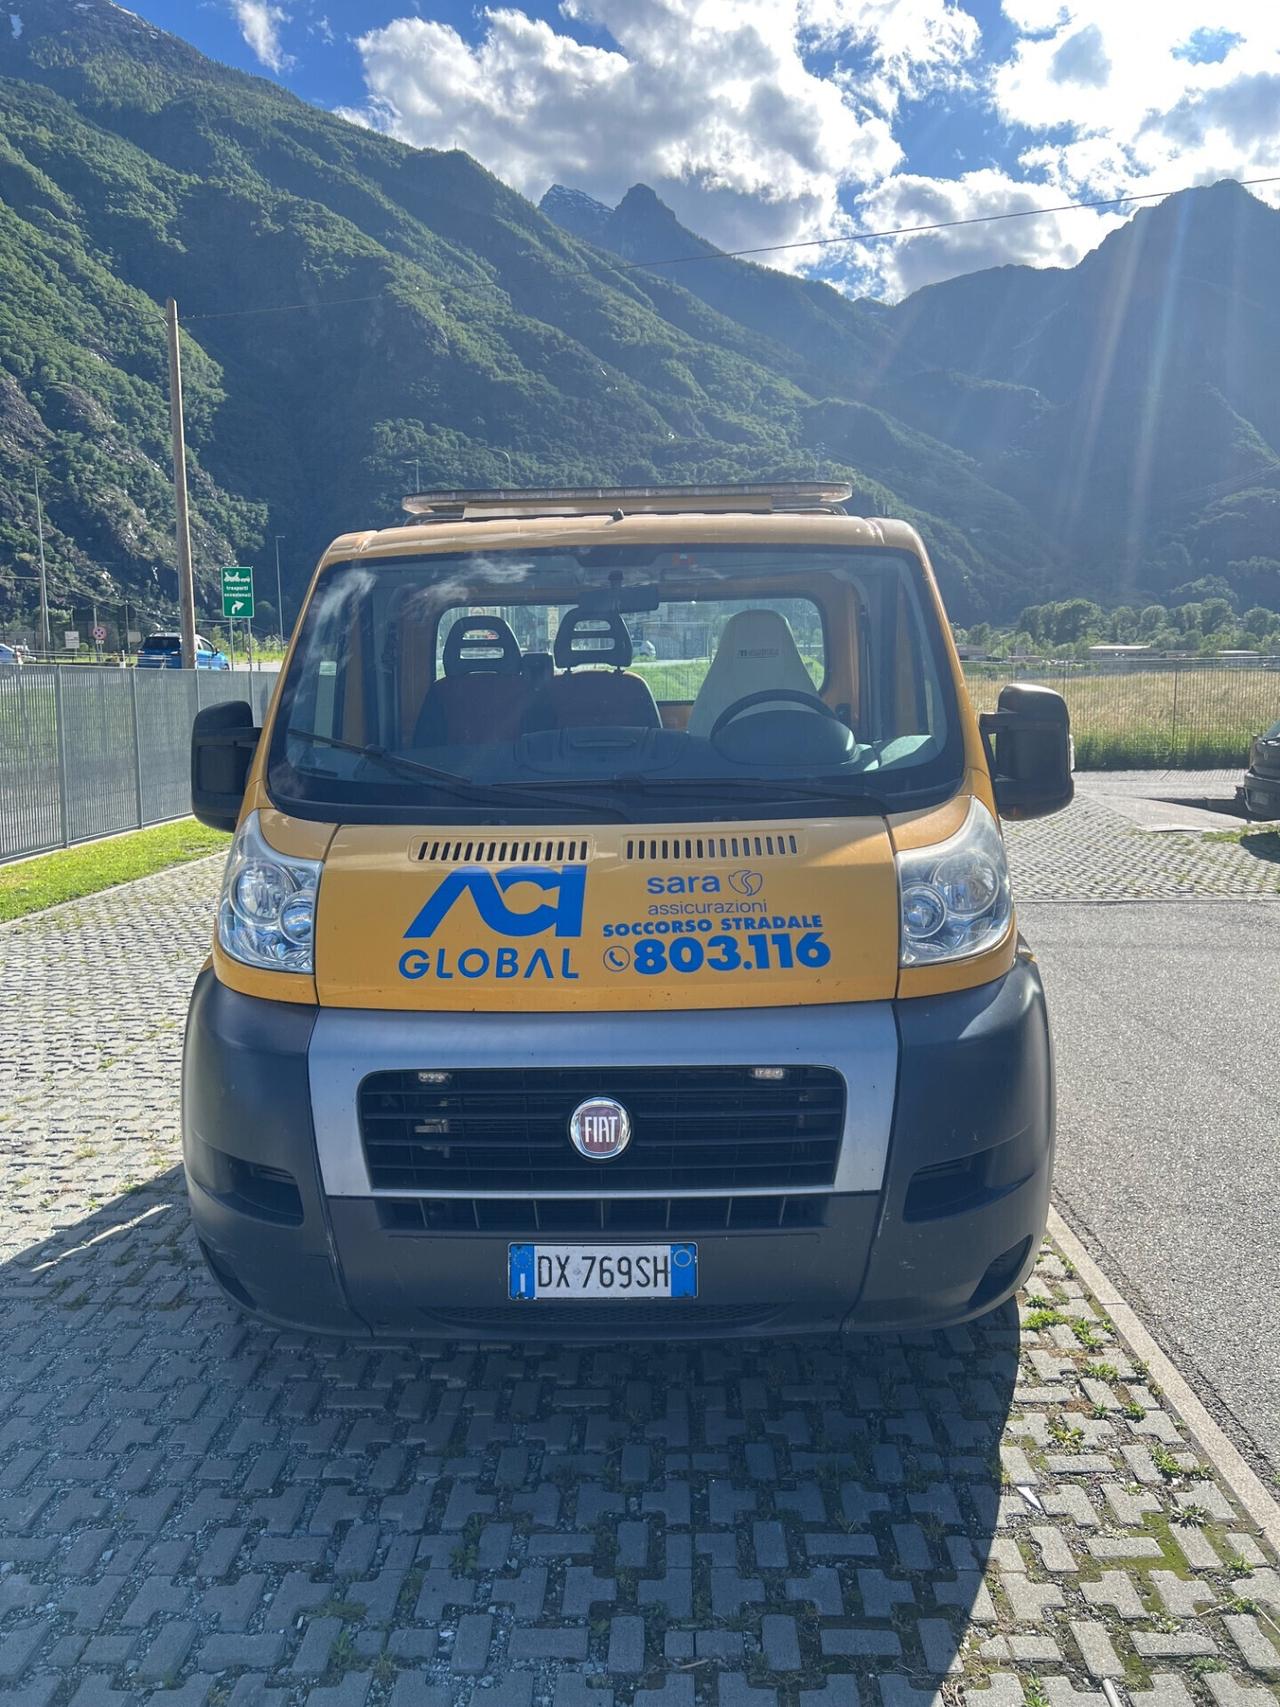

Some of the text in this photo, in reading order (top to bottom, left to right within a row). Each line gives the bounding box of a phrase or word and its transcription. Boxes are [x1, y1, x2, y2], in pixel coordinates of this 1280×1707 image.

[647, 875, 721, 894] sara
[403, 865, 587, 938] ACI
[647, 899, 767, 915] assicurazioni
[603, 915, 823, 937] SOCCORSO STRADALE
[399, 947, 579, 980] GLOBAL
[634, 932, 831, 975] 803.116
[584, 1116, 618, 1143] FIAT
